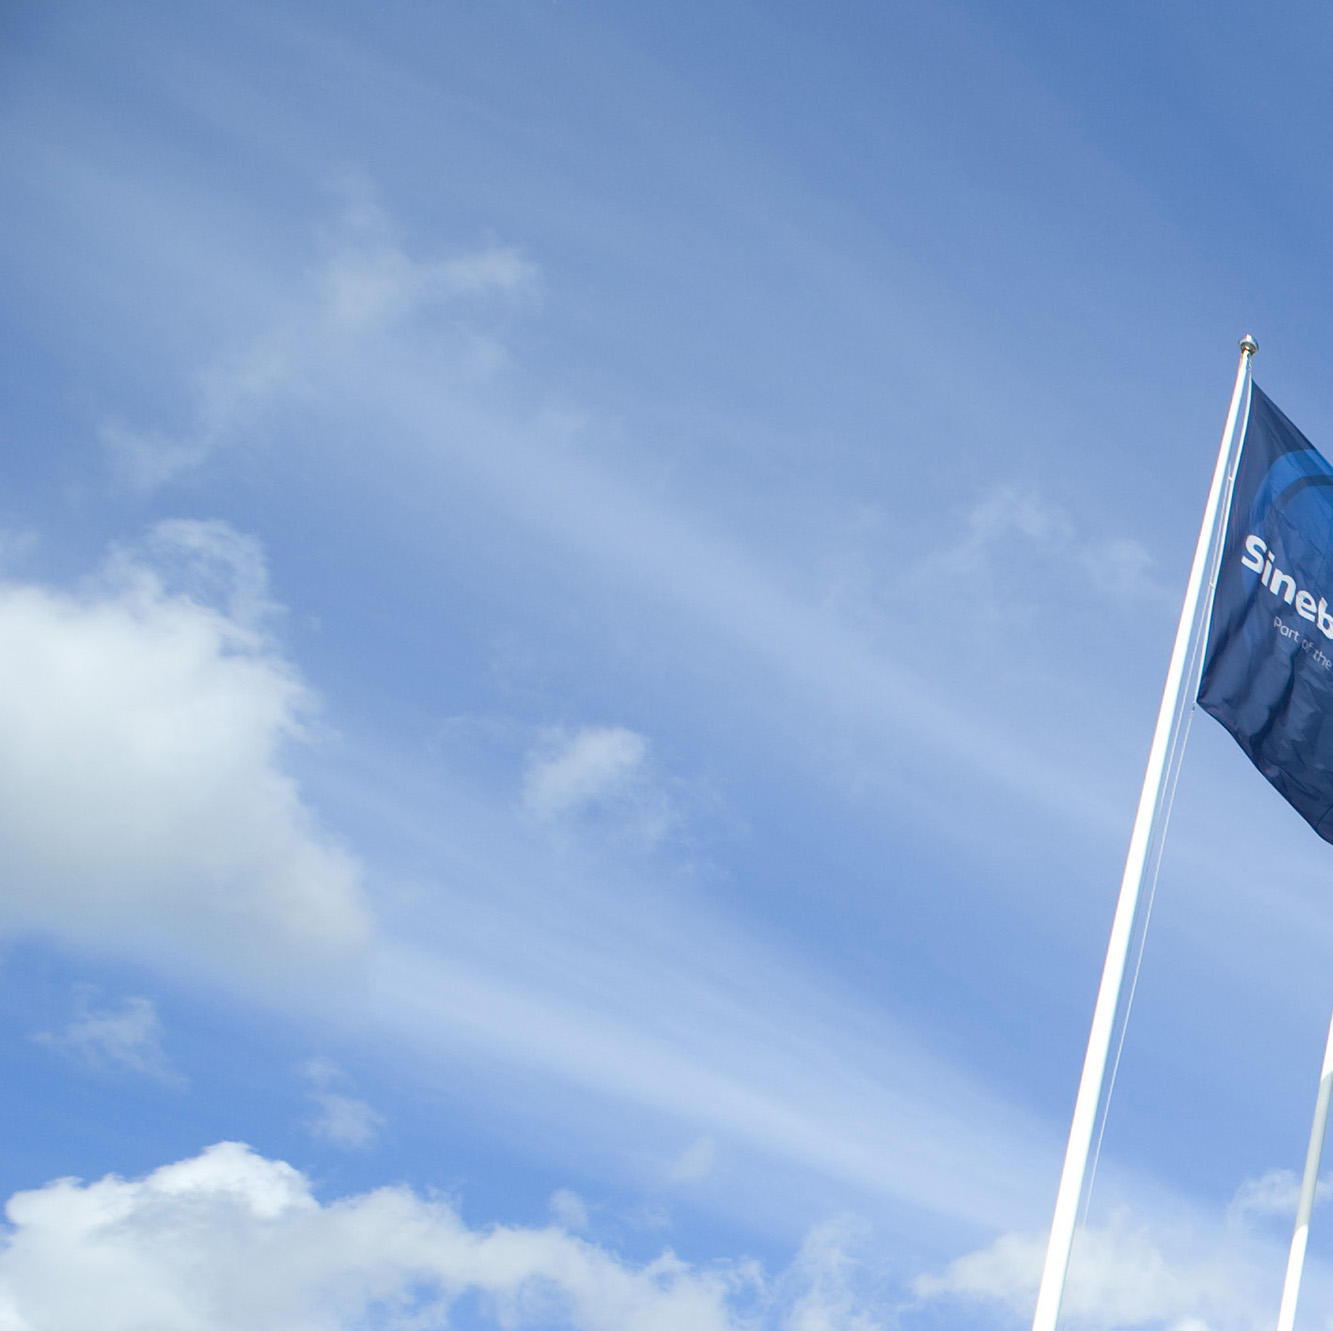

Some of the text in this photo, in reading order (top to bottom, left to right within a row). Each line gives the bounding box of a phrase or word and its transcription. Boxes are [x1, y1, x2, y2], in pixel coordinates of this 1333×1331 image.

[1273, 616, 1300, 642] Part
[1301, 638, 1315, 653] of
[1312, 649, 1332, 671] the
